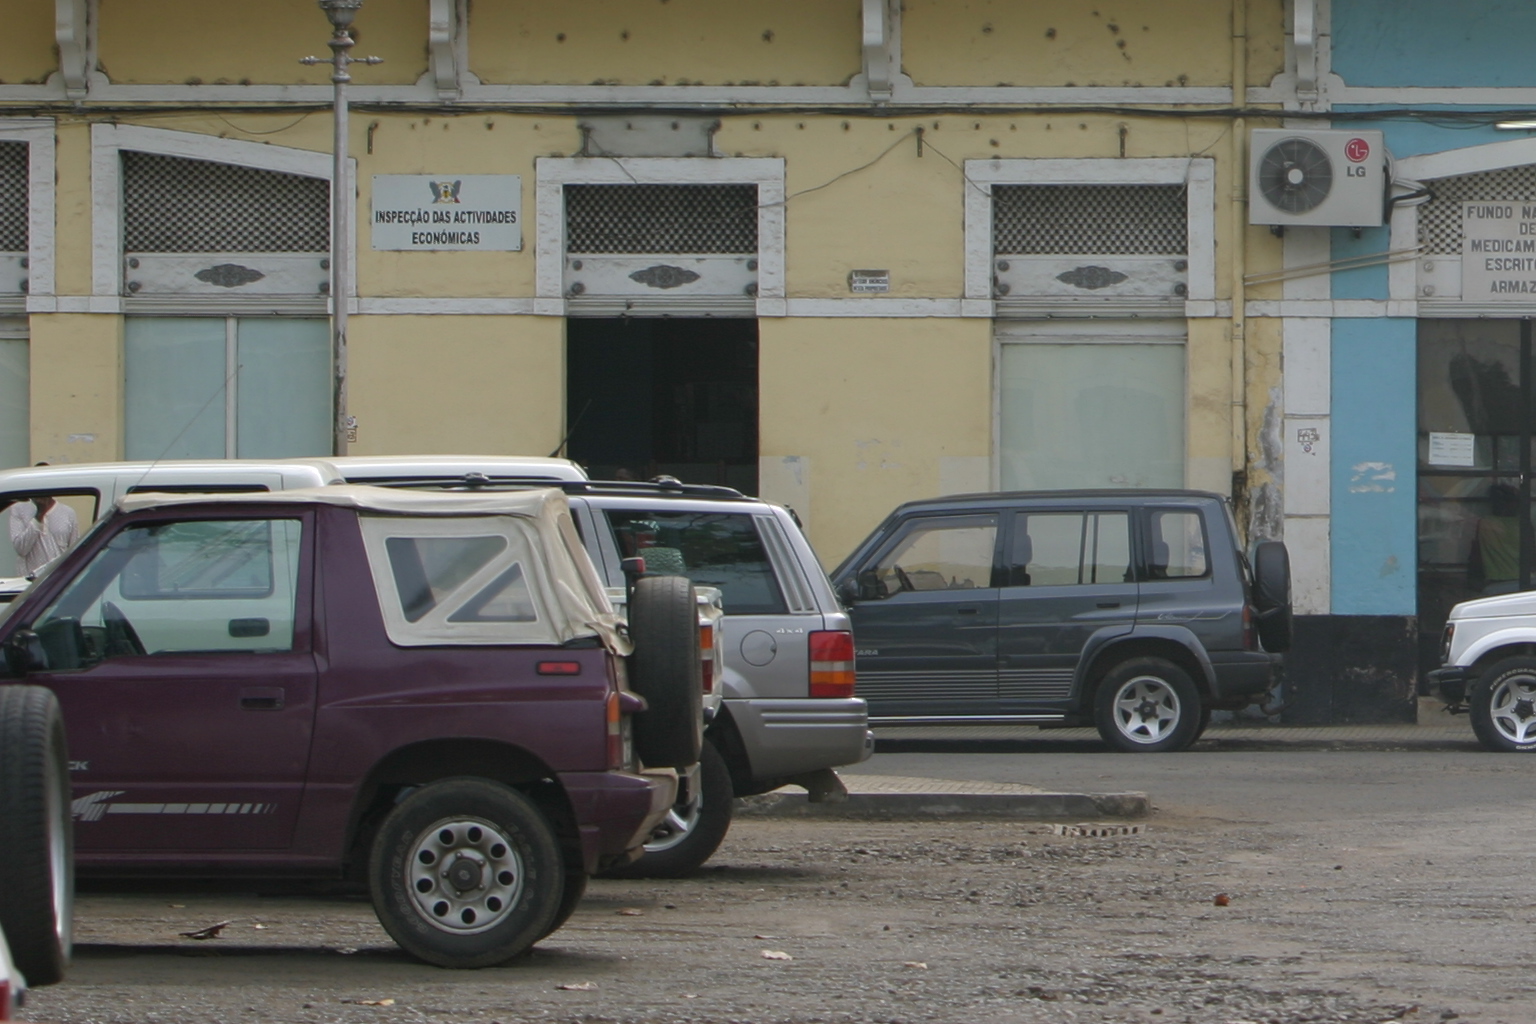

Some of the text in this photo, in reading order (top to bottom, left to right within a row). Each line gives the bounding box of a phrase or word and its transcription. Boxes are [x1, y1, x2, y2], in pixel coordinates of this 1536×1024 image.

[1347, 166, 1366, 178] LG
[375, 208, 517, 226] INSPECÇÃO DAS ACTIVIDADES
[1467, 206, 1513, 219] FUNDO
[1519, 223, 1536, 236] DE
[412, 229, 480, 245] ECONÓMICAS
